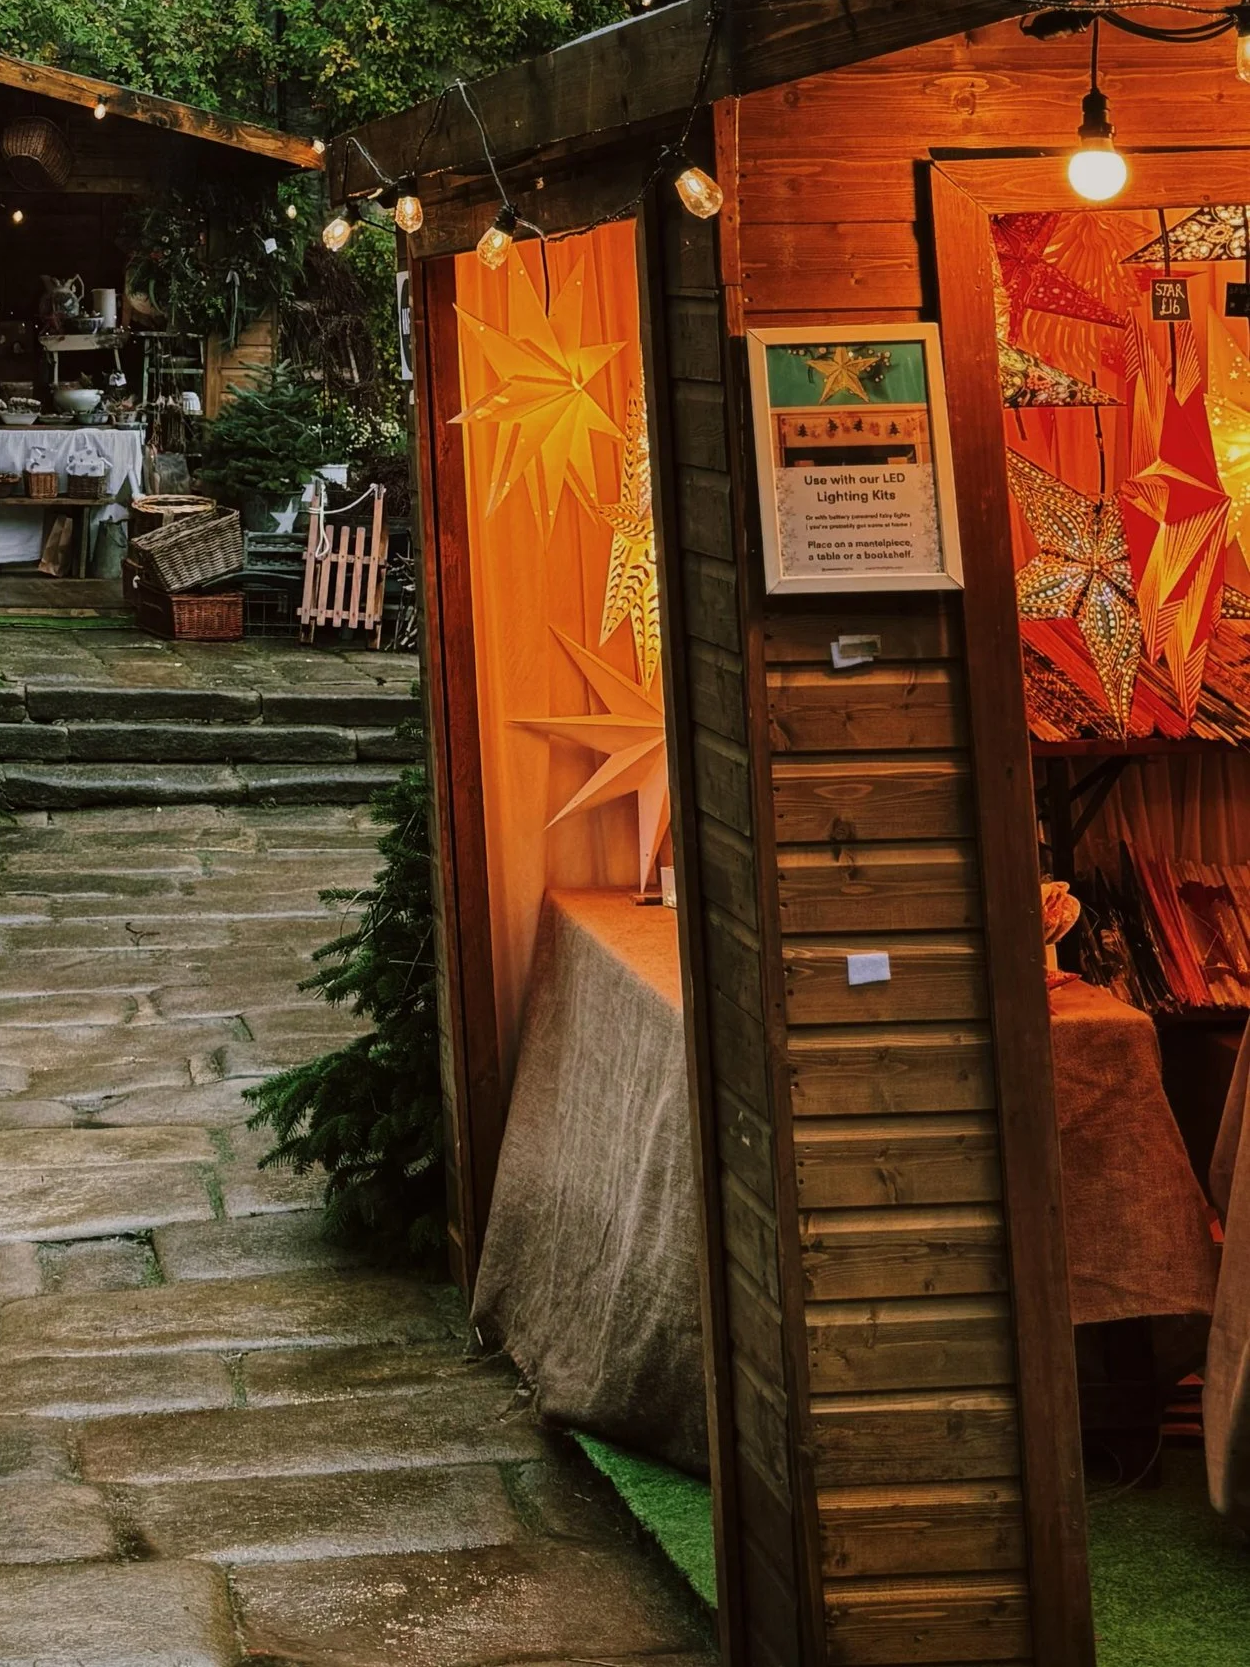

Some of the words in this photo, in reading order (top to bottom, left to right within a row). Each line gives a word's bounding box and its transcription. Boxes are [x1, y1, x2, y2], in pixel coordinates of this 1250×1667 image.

[1154, 282, 1185, 299] STAR
[1159, 297, 1181, 316] £16
[804, 475, 827, 486] Use
[830, 473, 856, 485] with
[859, 475, 880, 484] our
[883, 472, 906, 483] LED
[817, 490, 868, 505] Lighting
[872, 489, 896, 501] Kits
[879, 512, 892, 520] fairy
[894, 512, 910, 520] lights
[807, 540, 832, 549] Place
[855, 538, 913, 549] mantelpiece,
[817, 551, 841, 561] table
[843, 552, 854, 560] or
[864, 550, 914, 560] bookshelf.
